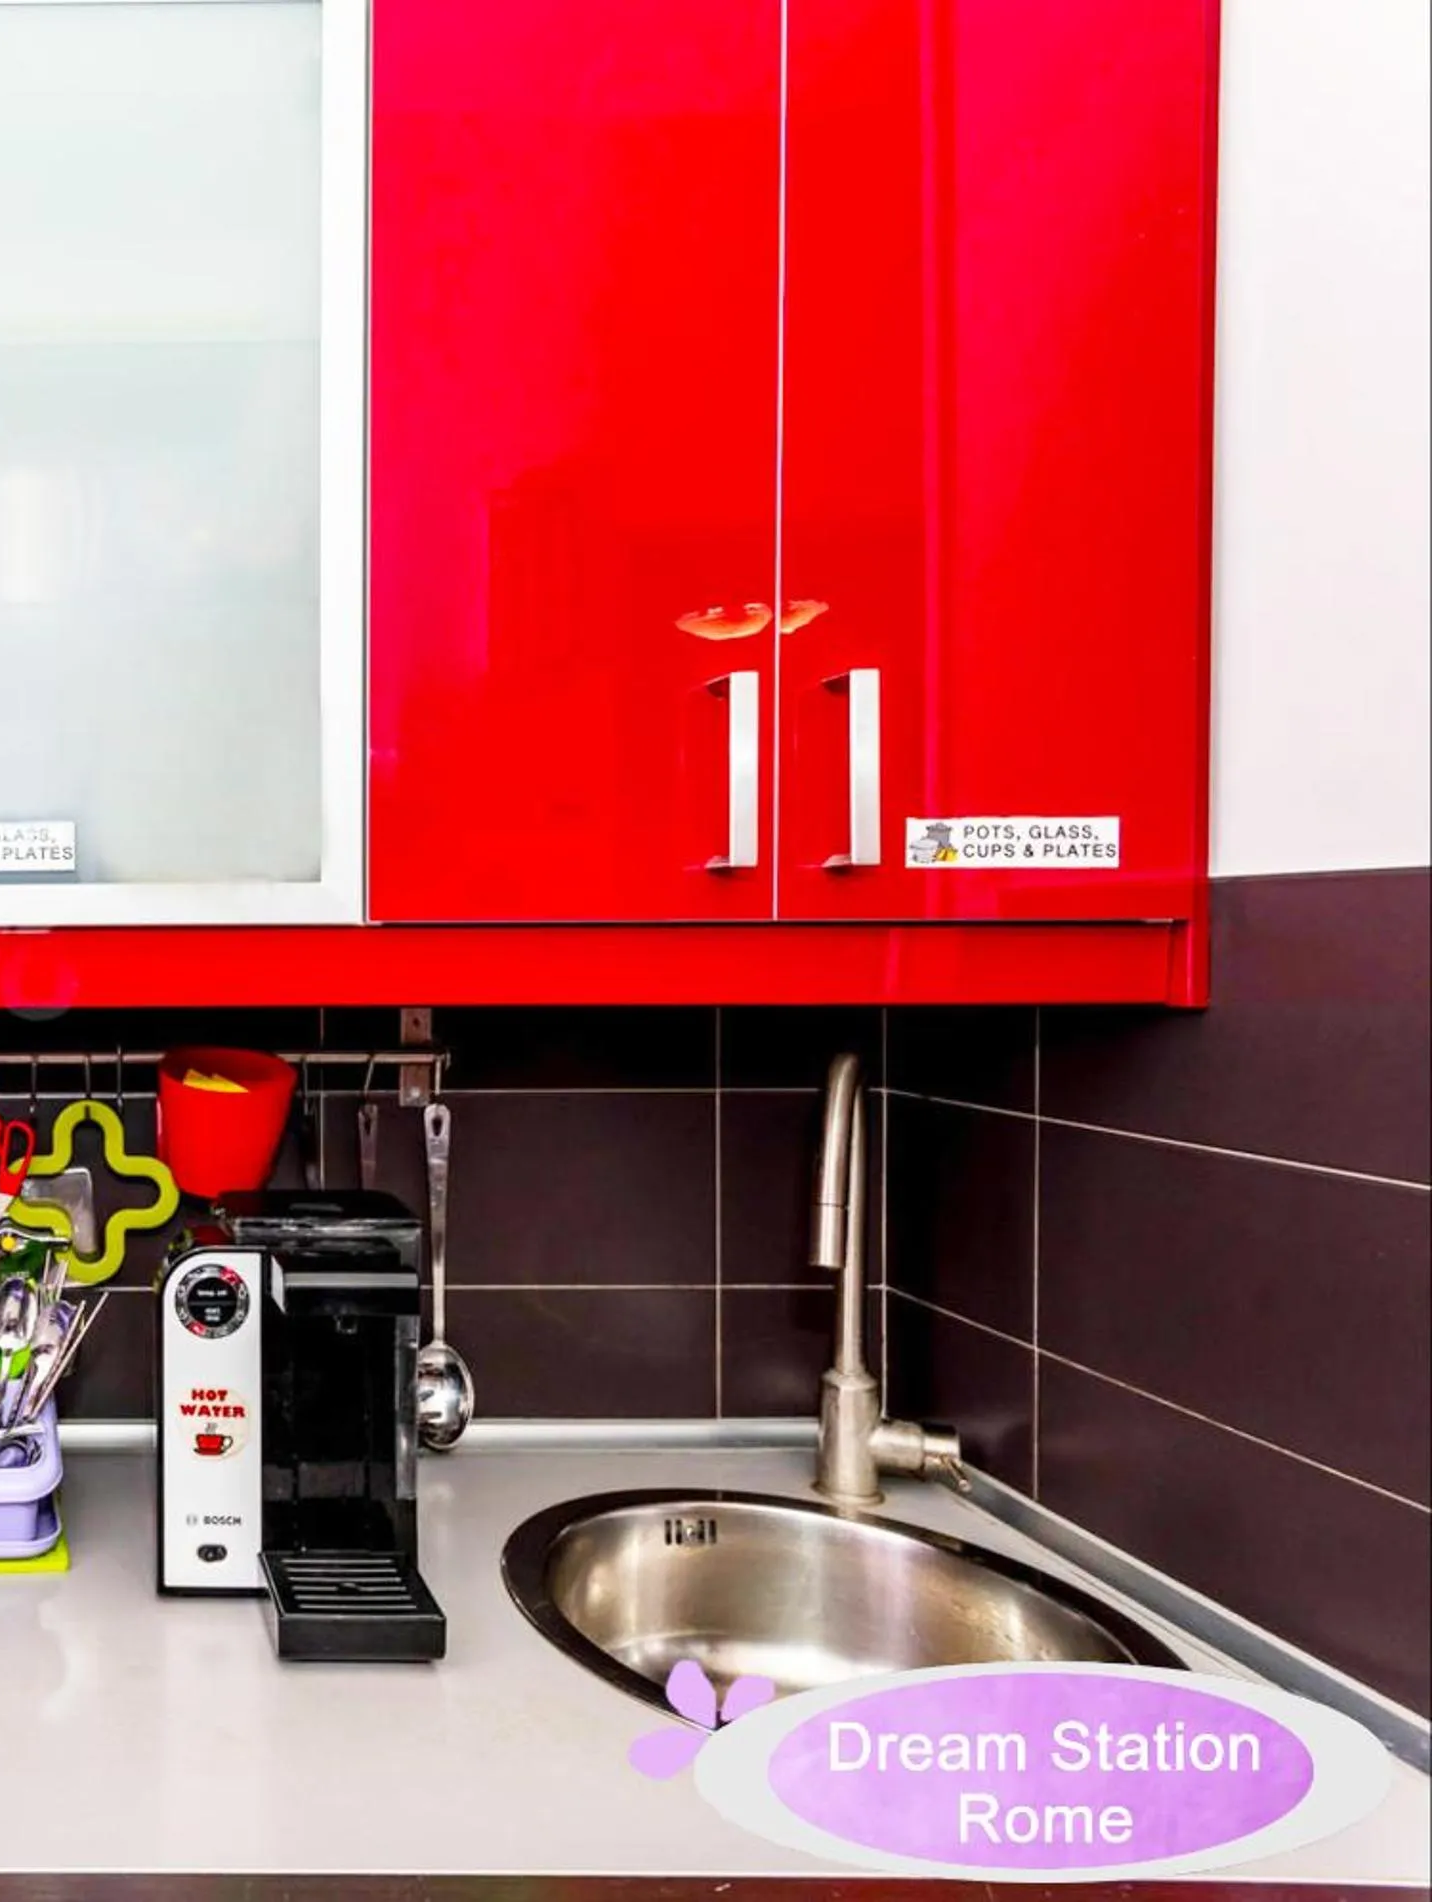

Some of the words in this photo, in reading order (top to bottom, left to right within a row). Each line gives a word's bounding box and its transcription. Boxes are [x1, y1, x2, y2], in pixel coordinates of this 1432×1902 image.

[963, 825, 1021, 841] POTS,
[1028, 825, 1100, 841] GLASS,
[3, 847, 74, 861] PLATES
[962, 844, 1016, 858] CUPS
[1023, 844, 1035, 858] &
[1043, 844, 1117, 858] PLATES
[191, 1388, 228, 1402] HOT
[180, 1405, 246, 1418] WATER
[204, 1515, 241, 1526] BOSCH
